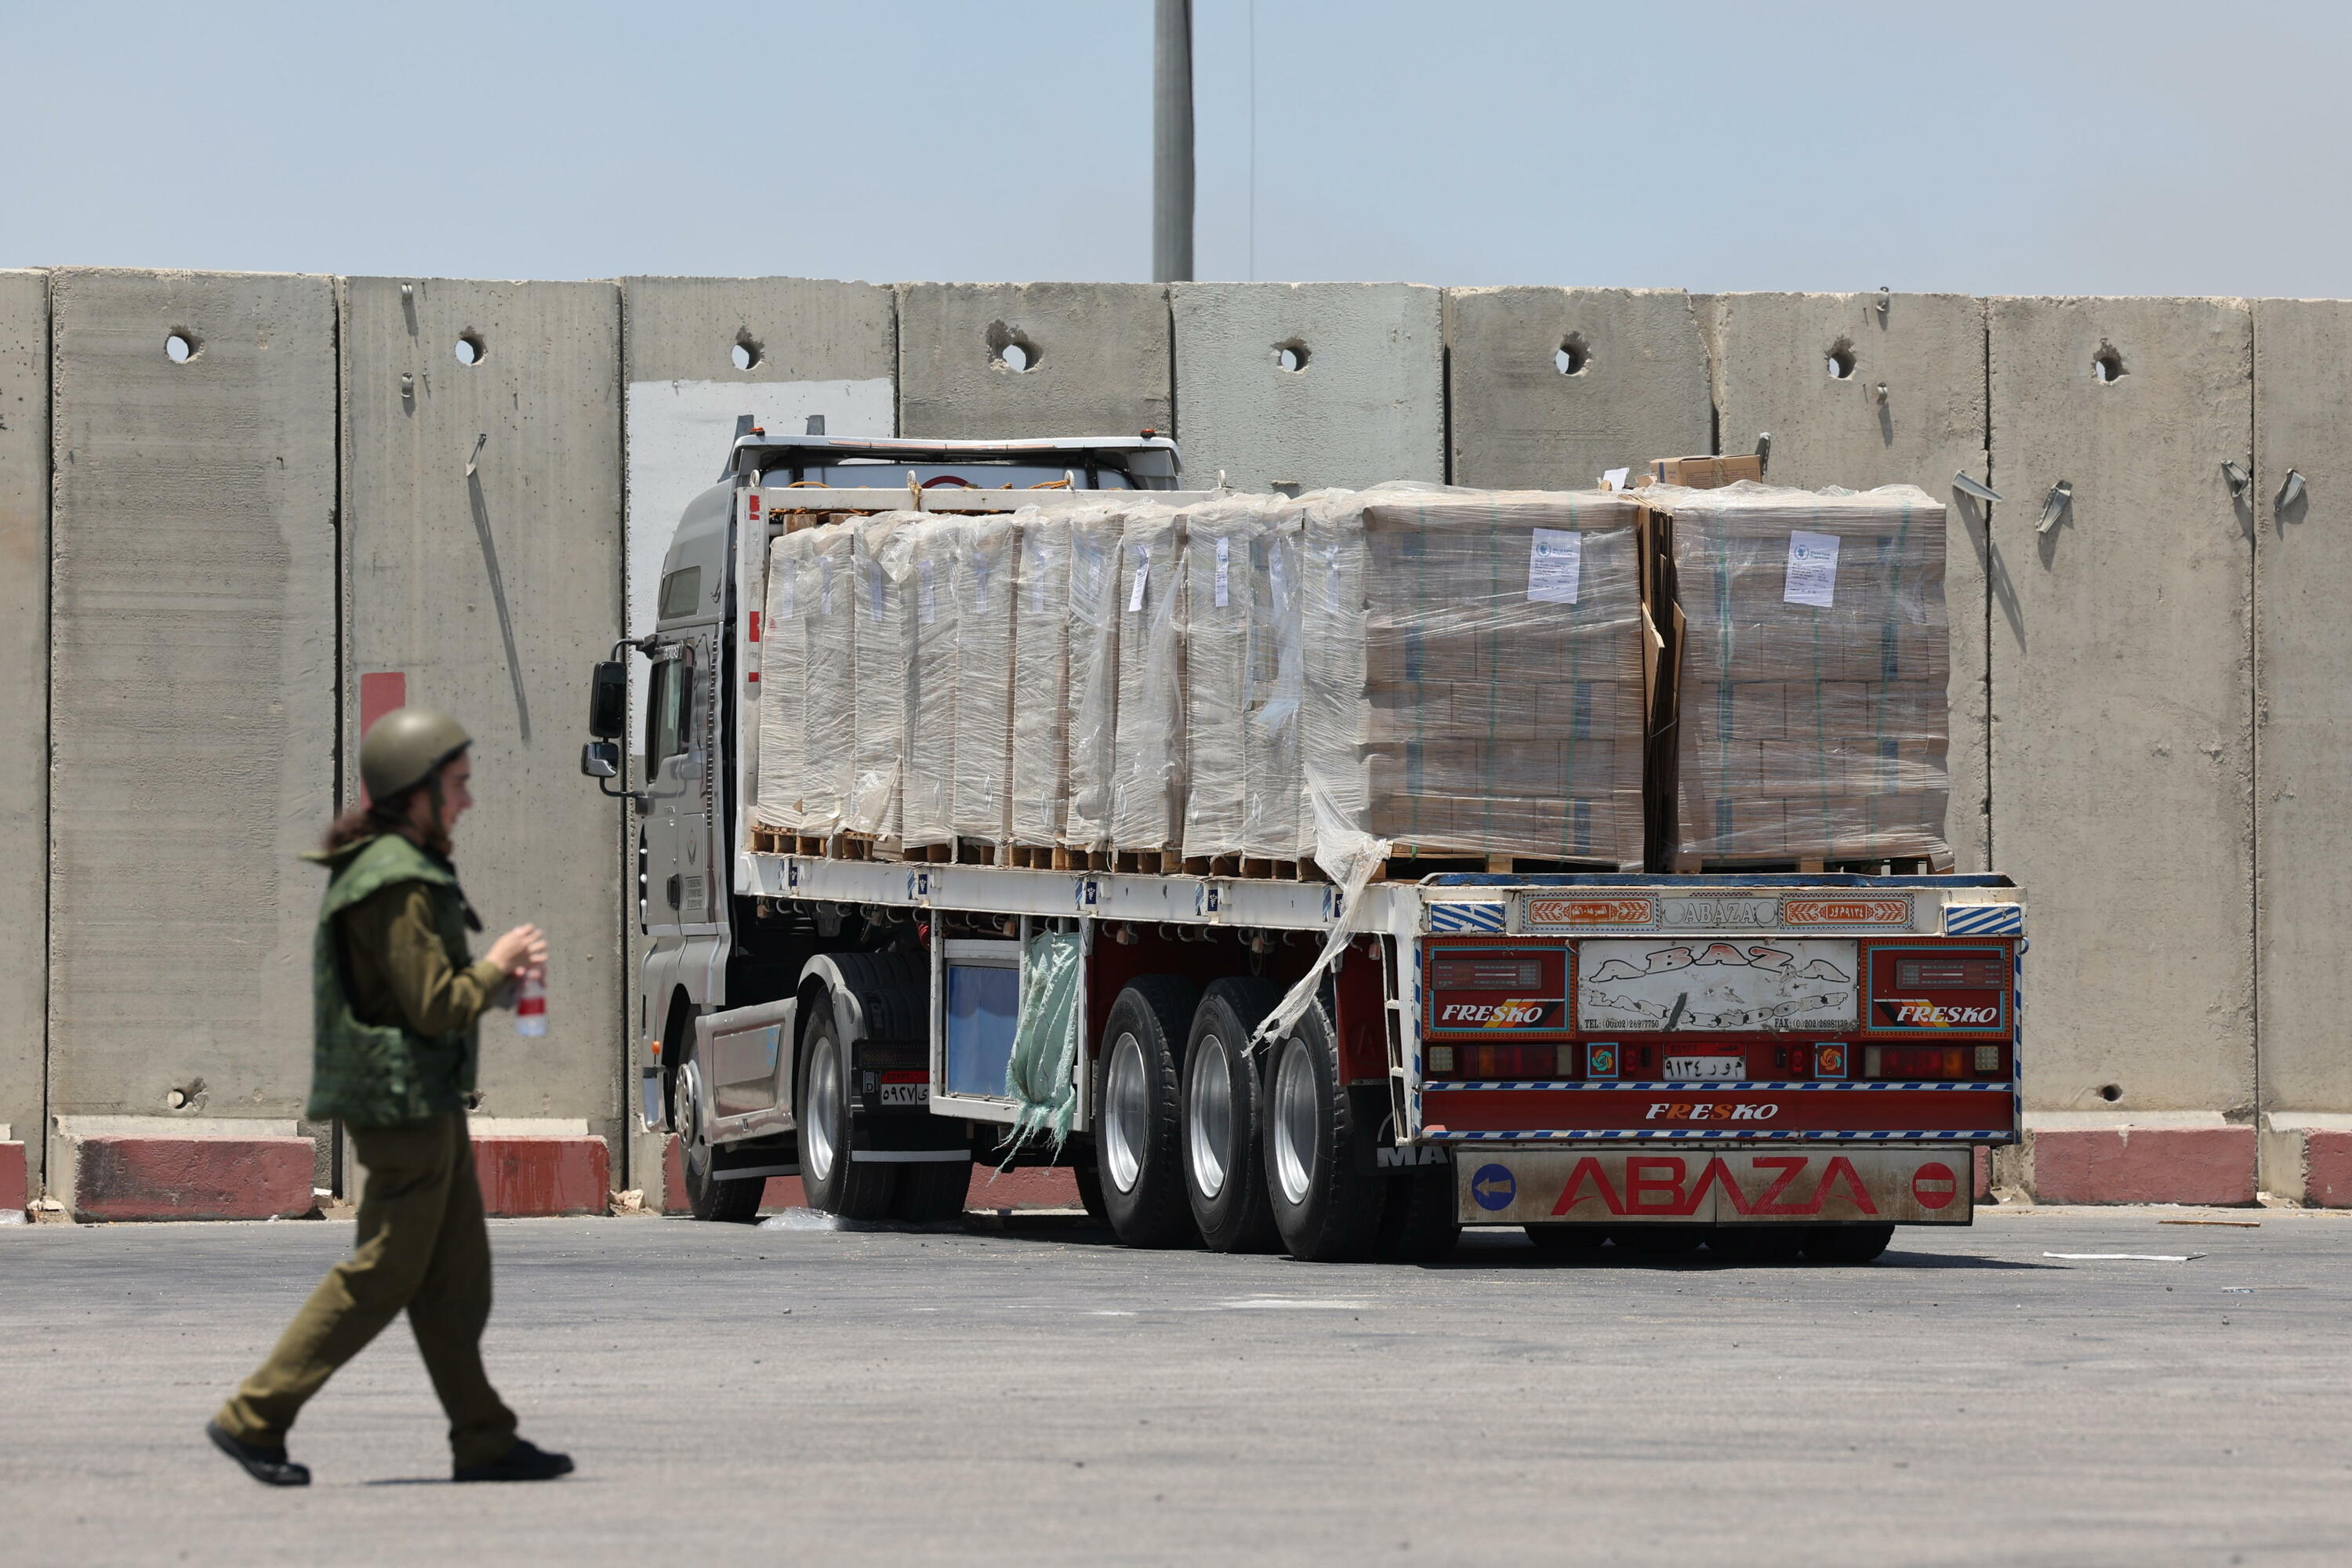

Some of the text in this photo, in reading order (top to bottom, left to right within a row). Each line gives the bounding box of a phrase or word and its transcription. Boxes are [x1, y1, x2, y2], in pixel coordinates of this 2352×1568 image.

[1685, 902, 1756, 924] ABAZA
[1589, 942, 1850, 982] ABAZA
[1442, 1004, 1543, 1023] FRESKO
[1896, 1006, 1997, 1023] FRESKO
[1646, 1103, 1778, 1120] FRESKO
[1377, 1146, 1452, 1167] MA
[1551, 1156, 1879, 1215] ABAZA
